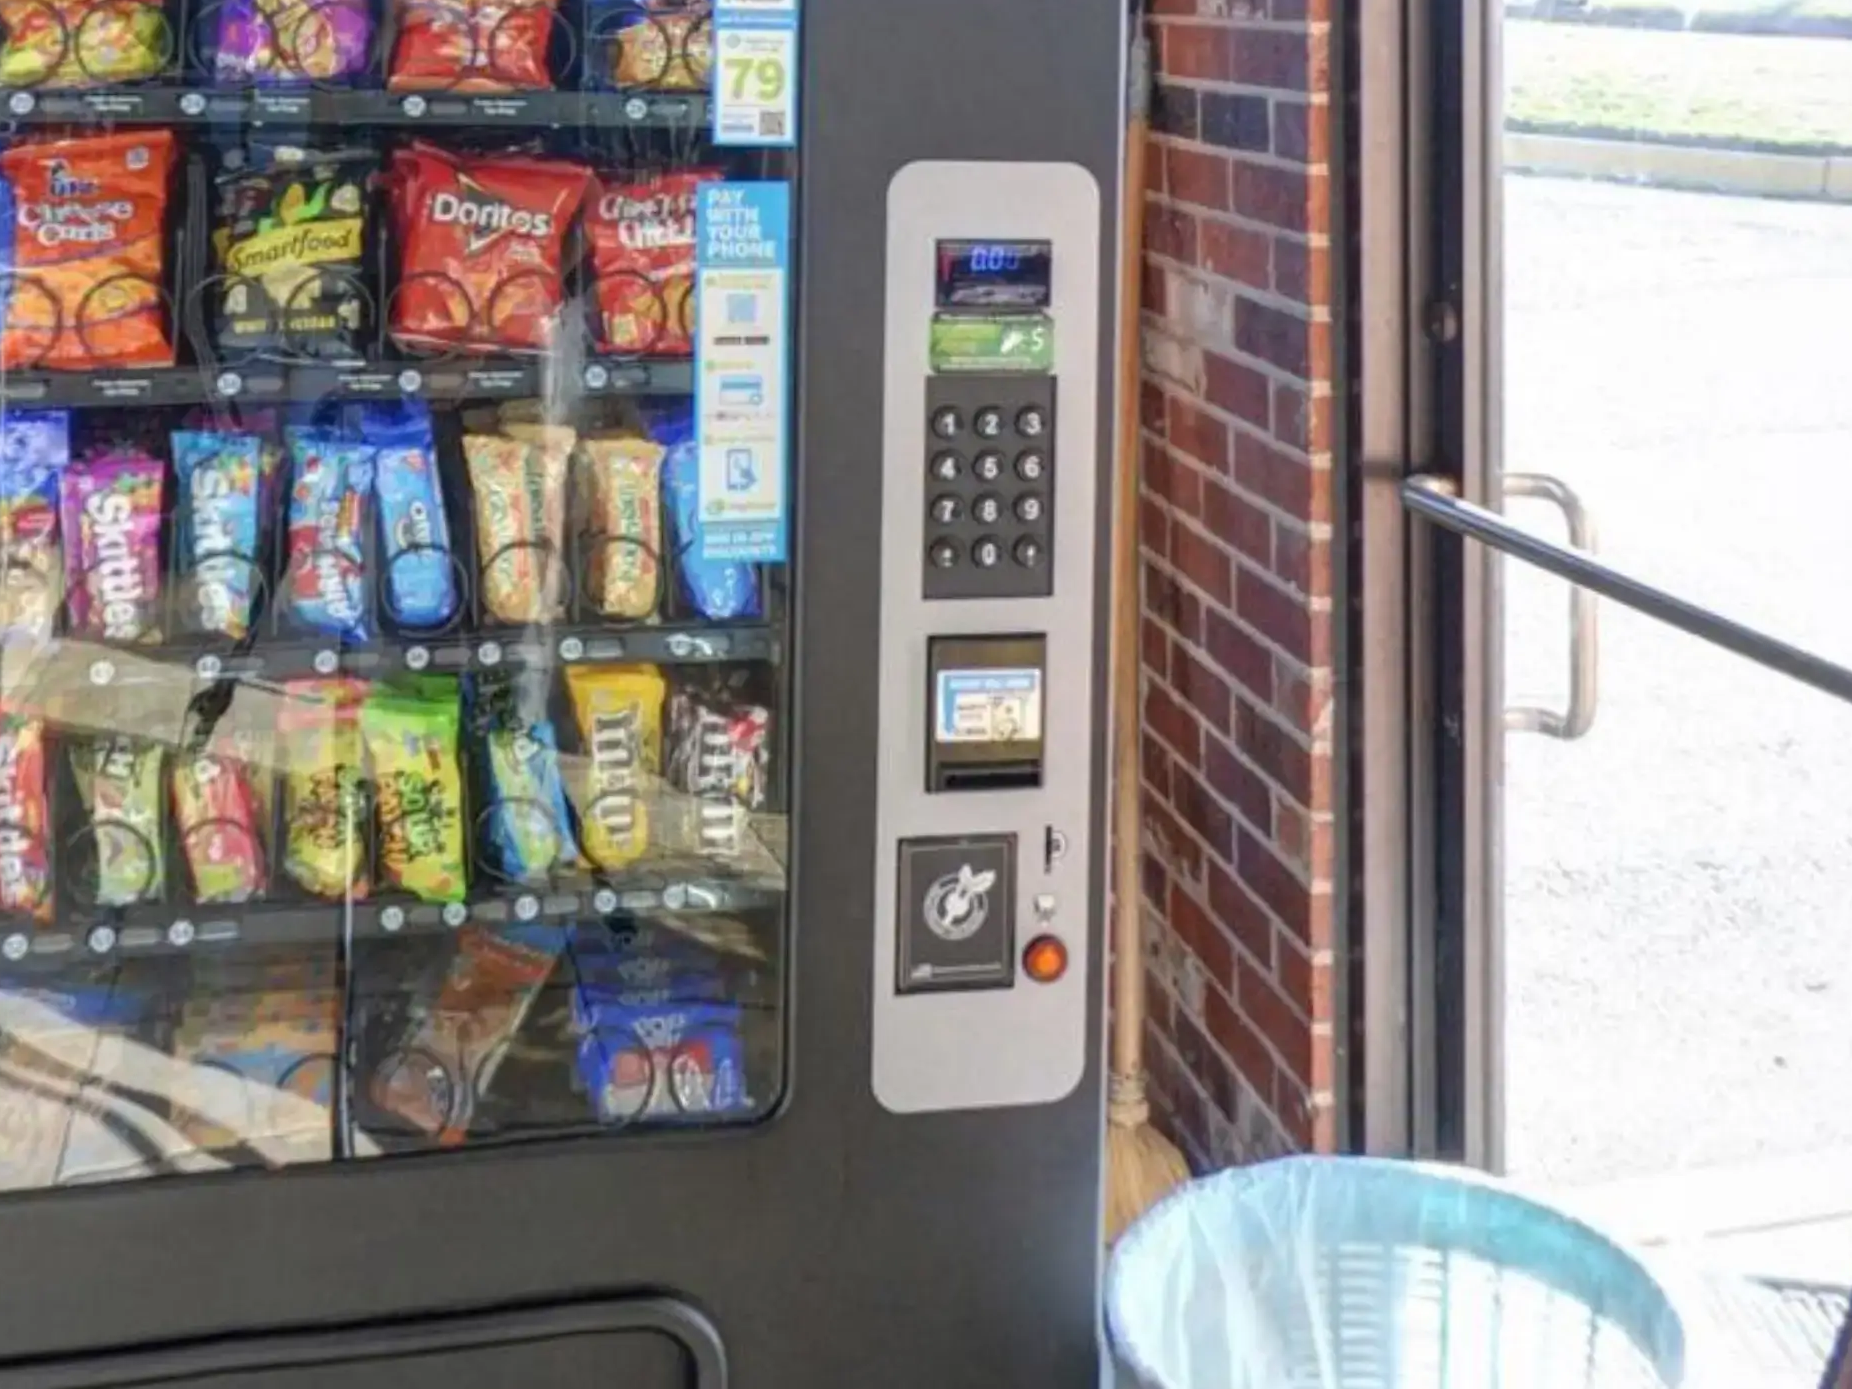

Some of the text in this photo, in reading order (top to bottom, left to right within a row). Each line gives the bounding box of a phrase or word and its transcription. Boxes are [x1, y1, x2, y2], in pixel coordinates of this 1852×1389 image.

[725, 58, 786, 101] 79
[707, 189, 744, 205] PAY
[432, 192, 550, 236] Doritos
[706, 207, 759, 223] WITH
[707, 225, 762, 241] YOUR
[230, 228, 352, 275] Smartfood
[707, 242, 777, 259] PHONE
[942, 414, 955, 435] 1
[984, 414, 999, 435] 2
[1026, 413, 1040, 434] 3
[940, 458, 954, 477] 4
[983, 456, 997, 477] 5
[1024, 456, 1039, 477] 6
[940, 501, 954, 522] 7
[982, 499, 996, 520] 8
[1024, 499, 1038, 519] 9
[982, 543, 994, 566] 0
[87, 493, 144, 640] Skittles
